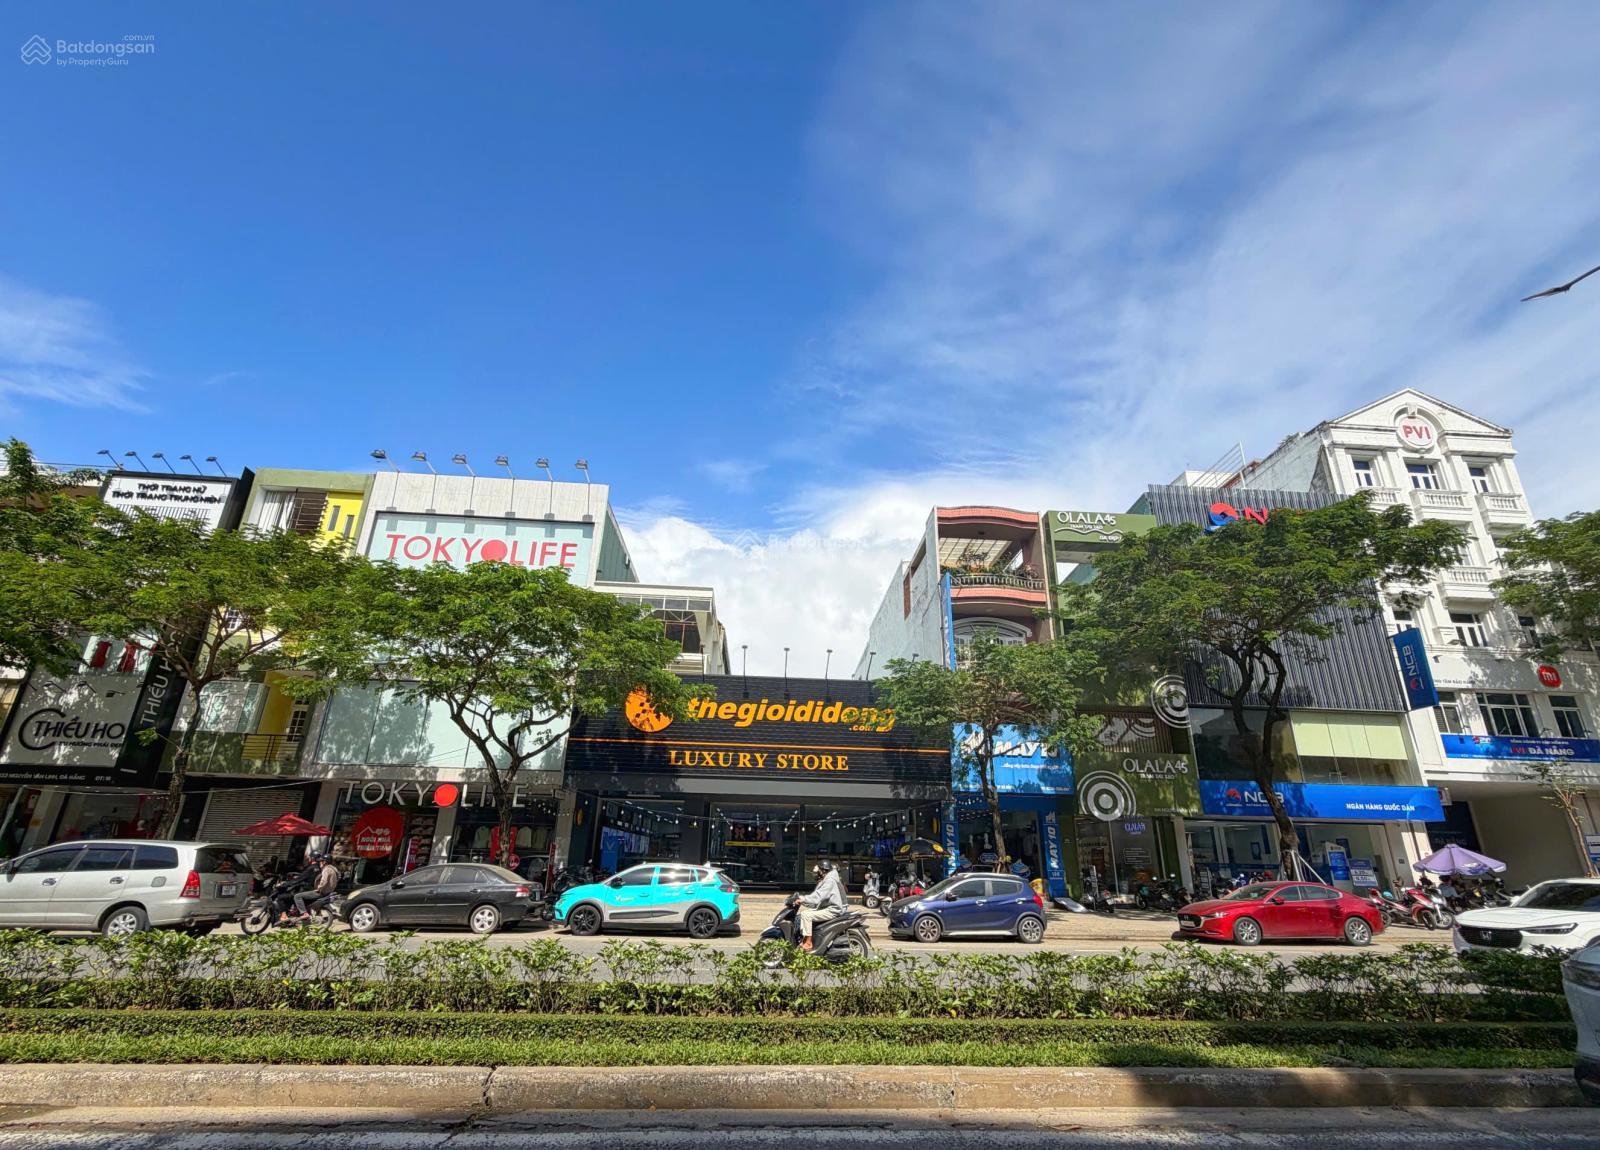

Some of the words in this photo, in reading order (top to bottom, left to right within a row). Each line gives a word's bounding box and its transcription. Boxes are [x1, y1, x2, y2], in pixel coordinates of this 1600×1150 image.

[1402, 425, 1431, 440] PVI
[1402, 645, 1417, 676] NCB
[668, 750, 769, 768] LUXURY
[776, 753, 849, 771] STORE
[1123, 758, 1189, 774] OLALA45
